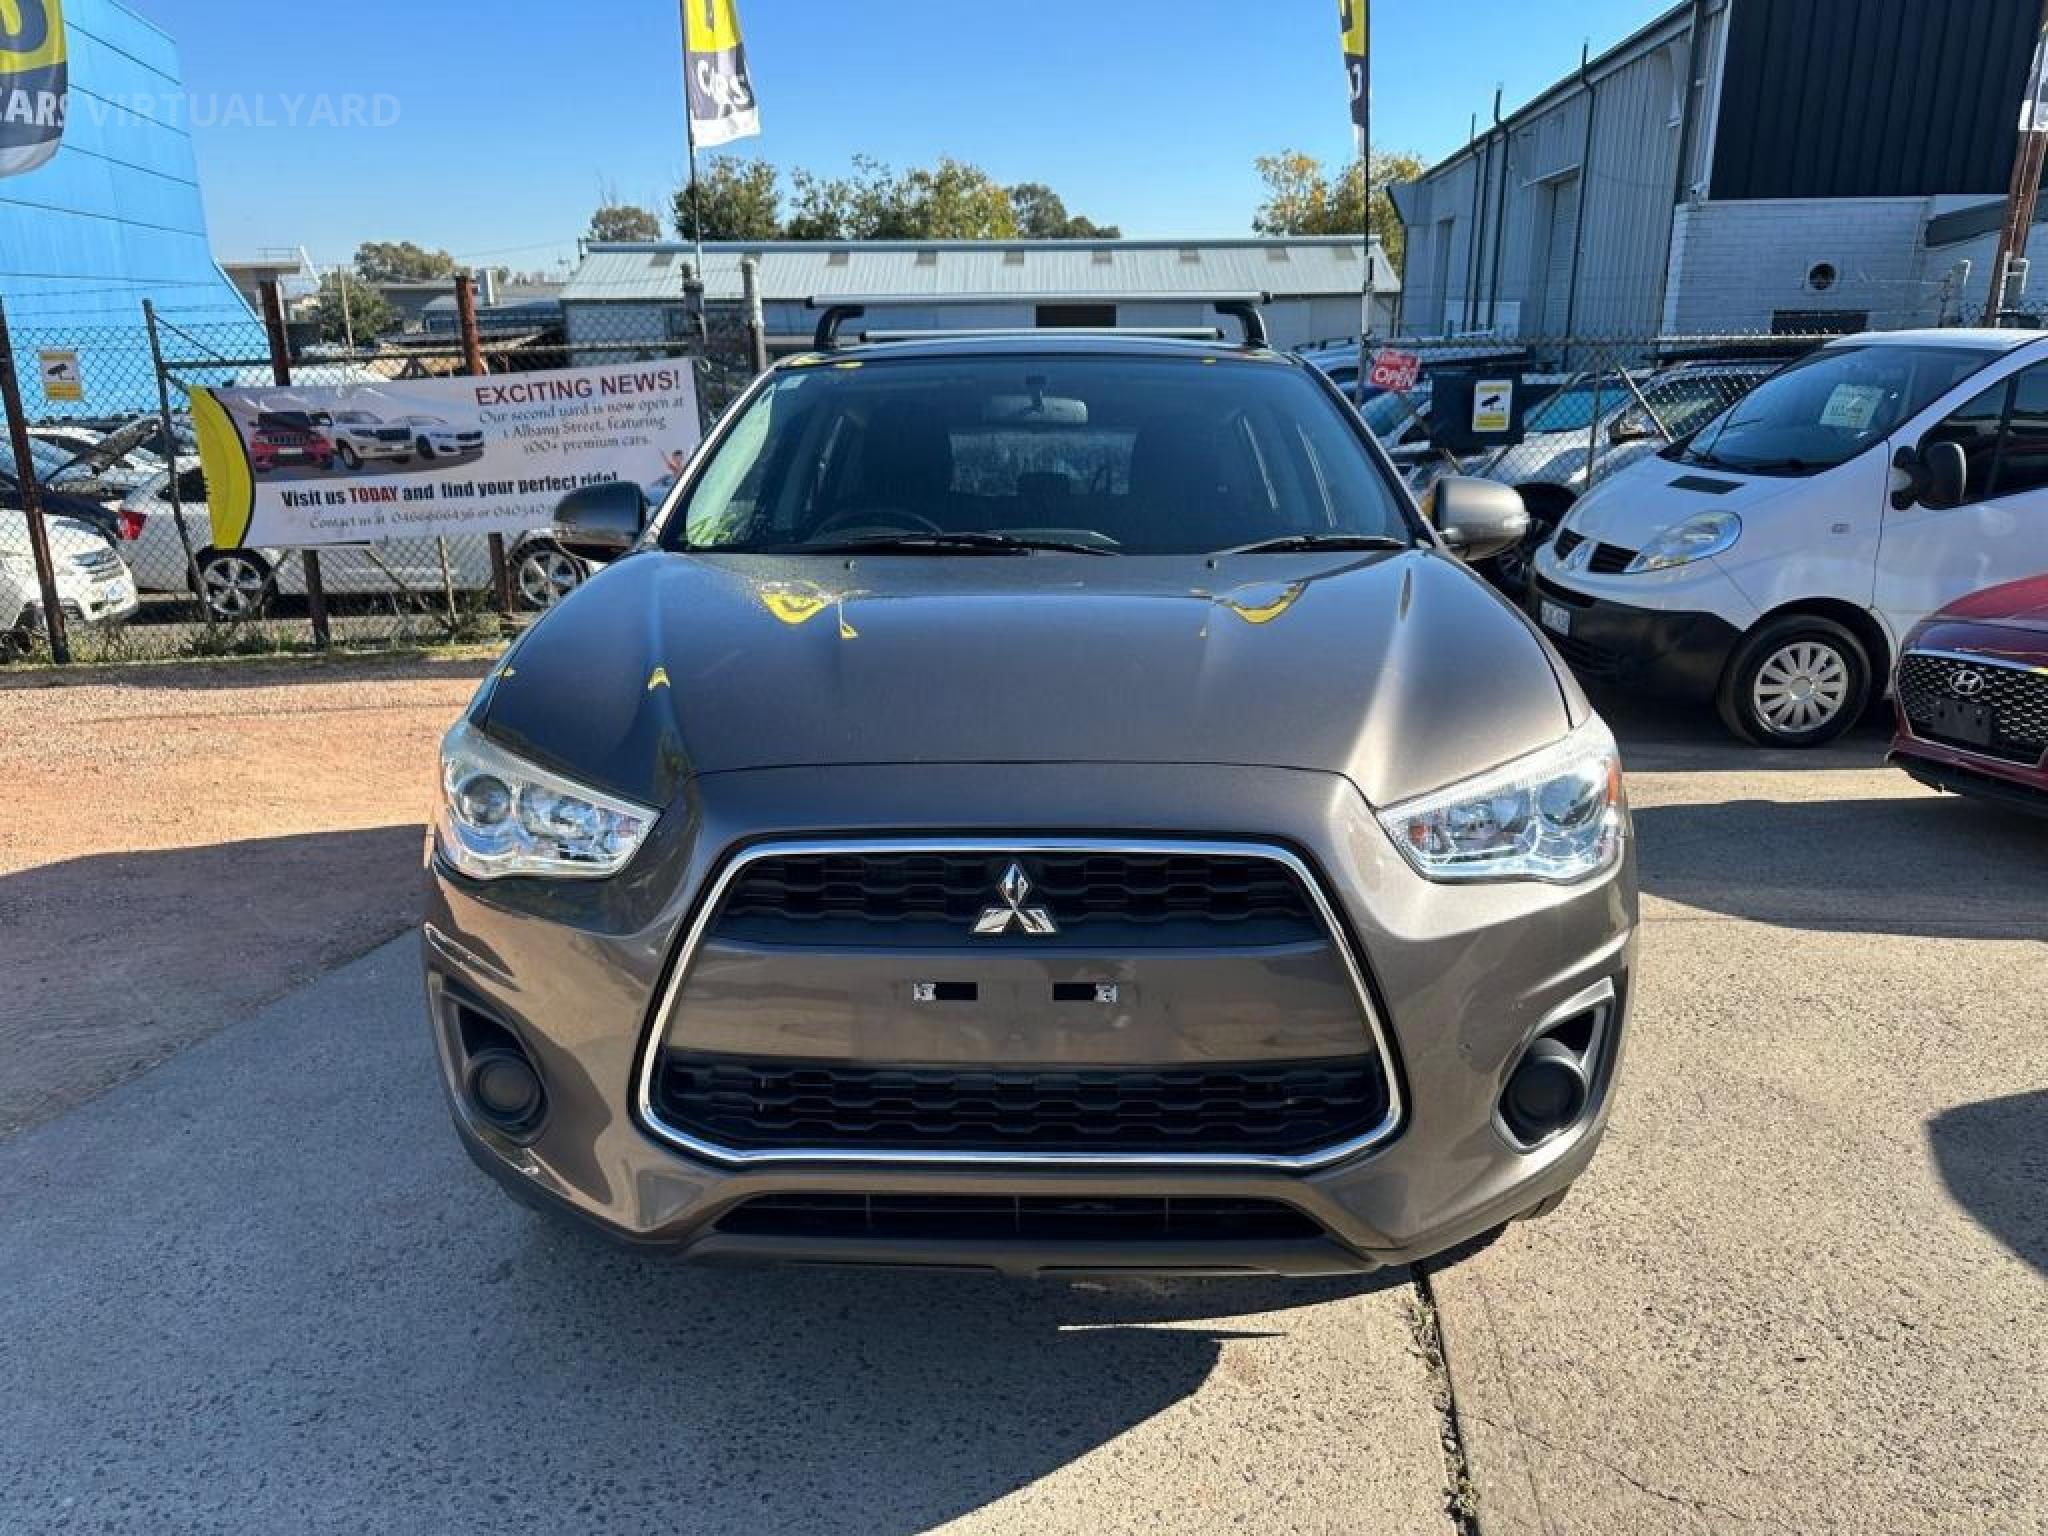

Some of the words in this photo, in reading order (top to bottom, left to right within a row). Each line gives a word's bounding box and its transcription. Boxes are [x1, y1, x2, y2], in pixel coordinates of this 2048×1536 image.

[0, 87, 65, 127] AR
[475, 378, 593, 406] EXCITING
[600, 370, 681, 395] NEWS!
[480, 409, 508, 424] Our
[511, 404, 555, 421] second
[559, 403, 589, 421] yard
[593, 403, 604, 415] is
[607, 401, 635, 414] now
[639, 398, 670, 414] open
[672, 396, 683, 409] at
[607, 415, 667, 431] featuring
[563, 437, 619, 455] premium
[281, 489, 323, 507] Visit
[326, 490, 346, 506] us
[348, 485, 399, 505] TODAY
[402, 483, 435, 501] and
[441, 480, 475, 499] find
[478, 481, 514, 498] your
[518, 475, 577, 495] perfect
